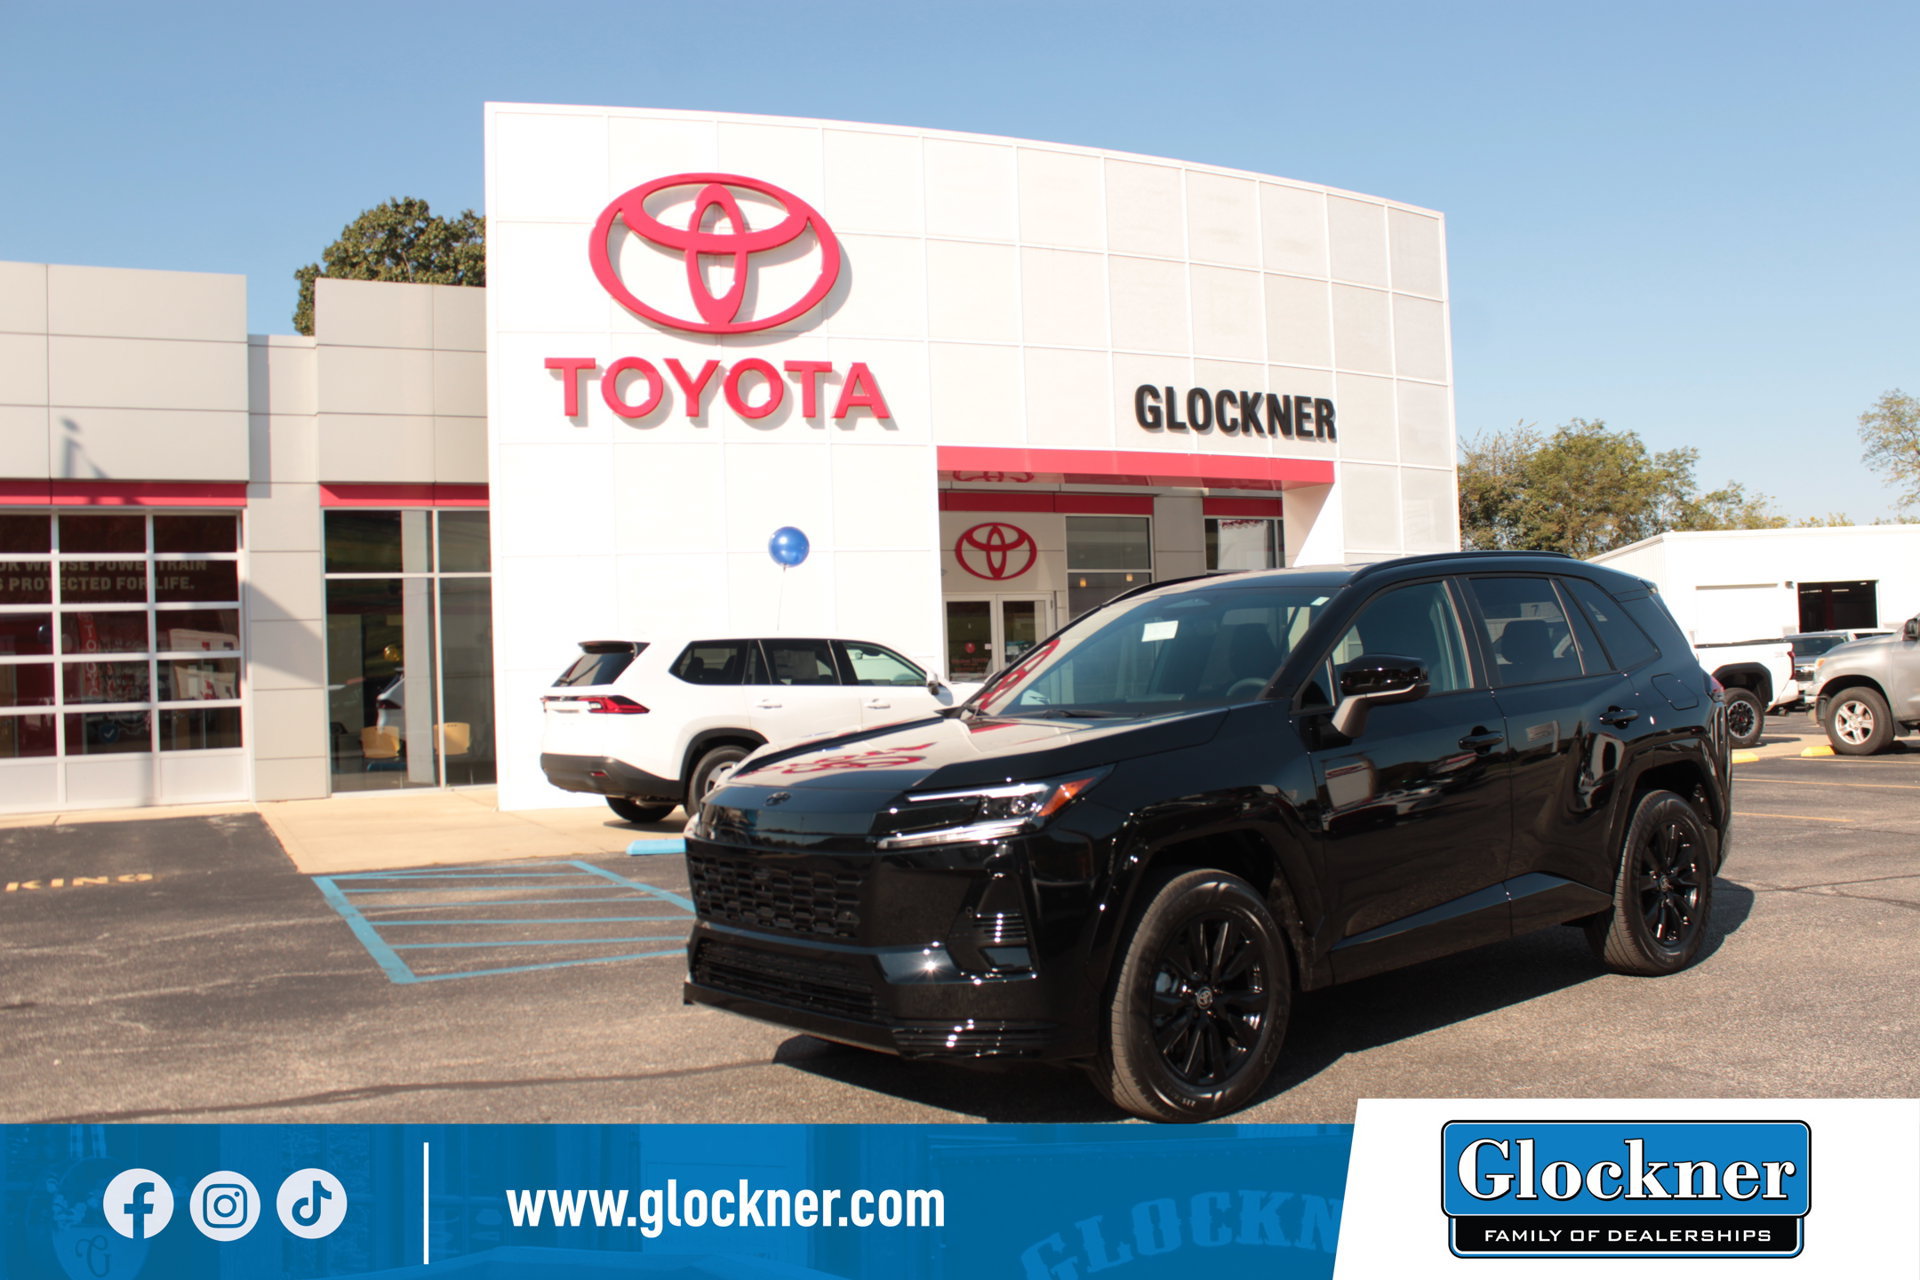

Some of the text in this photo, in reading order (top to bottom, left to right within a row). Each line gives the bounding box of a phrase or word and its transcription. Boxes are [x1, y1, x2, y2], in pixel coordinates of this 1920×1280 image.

[545, 356, 891, 419] TOYOTA
[1134, 383, 1338, 440] GLOCKNER
[95, 560, 207, 572] POWETRAIN
[116, 577, 149, 590] FOR
